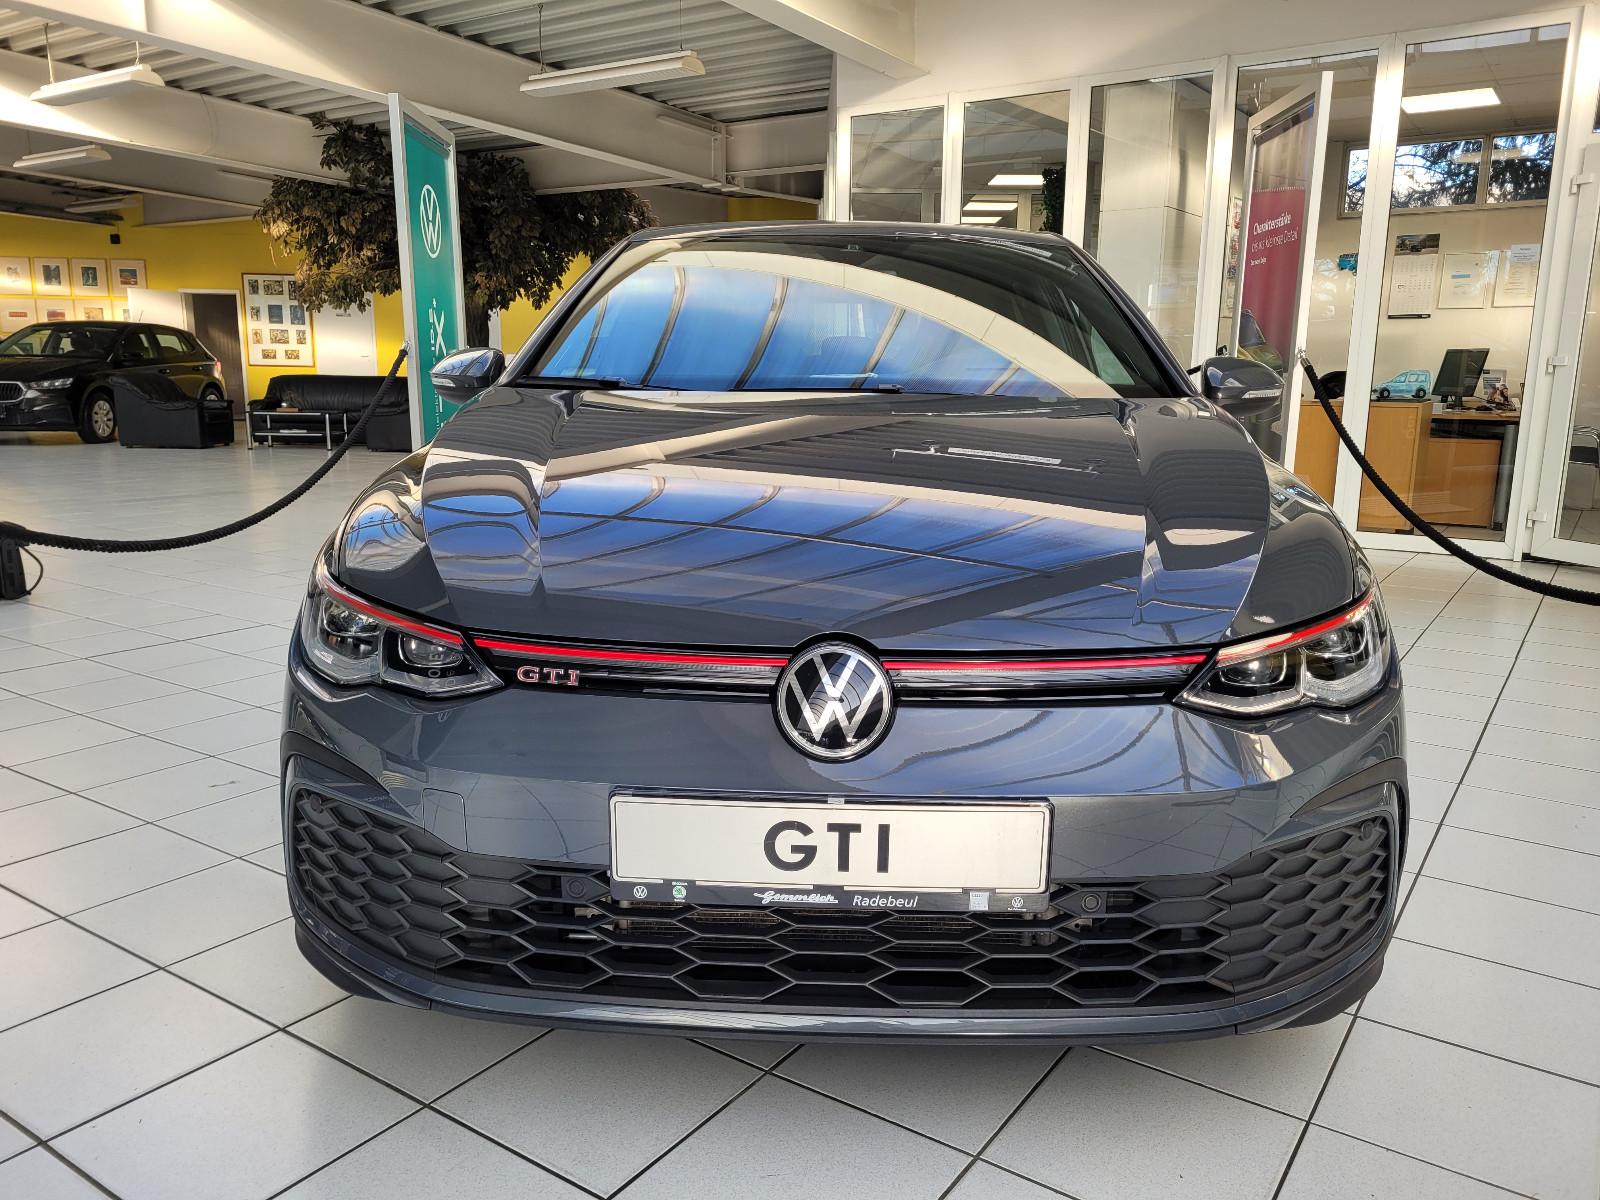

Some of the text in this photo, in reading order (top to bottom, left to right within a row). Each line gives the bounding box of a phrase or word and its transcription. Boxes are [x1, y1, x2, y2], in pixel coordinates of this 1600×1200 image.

[517, 665, 580, 686] GTI
[763, 820, 890, 873] GTI
[852, 895, 918, 907] Radebeul
